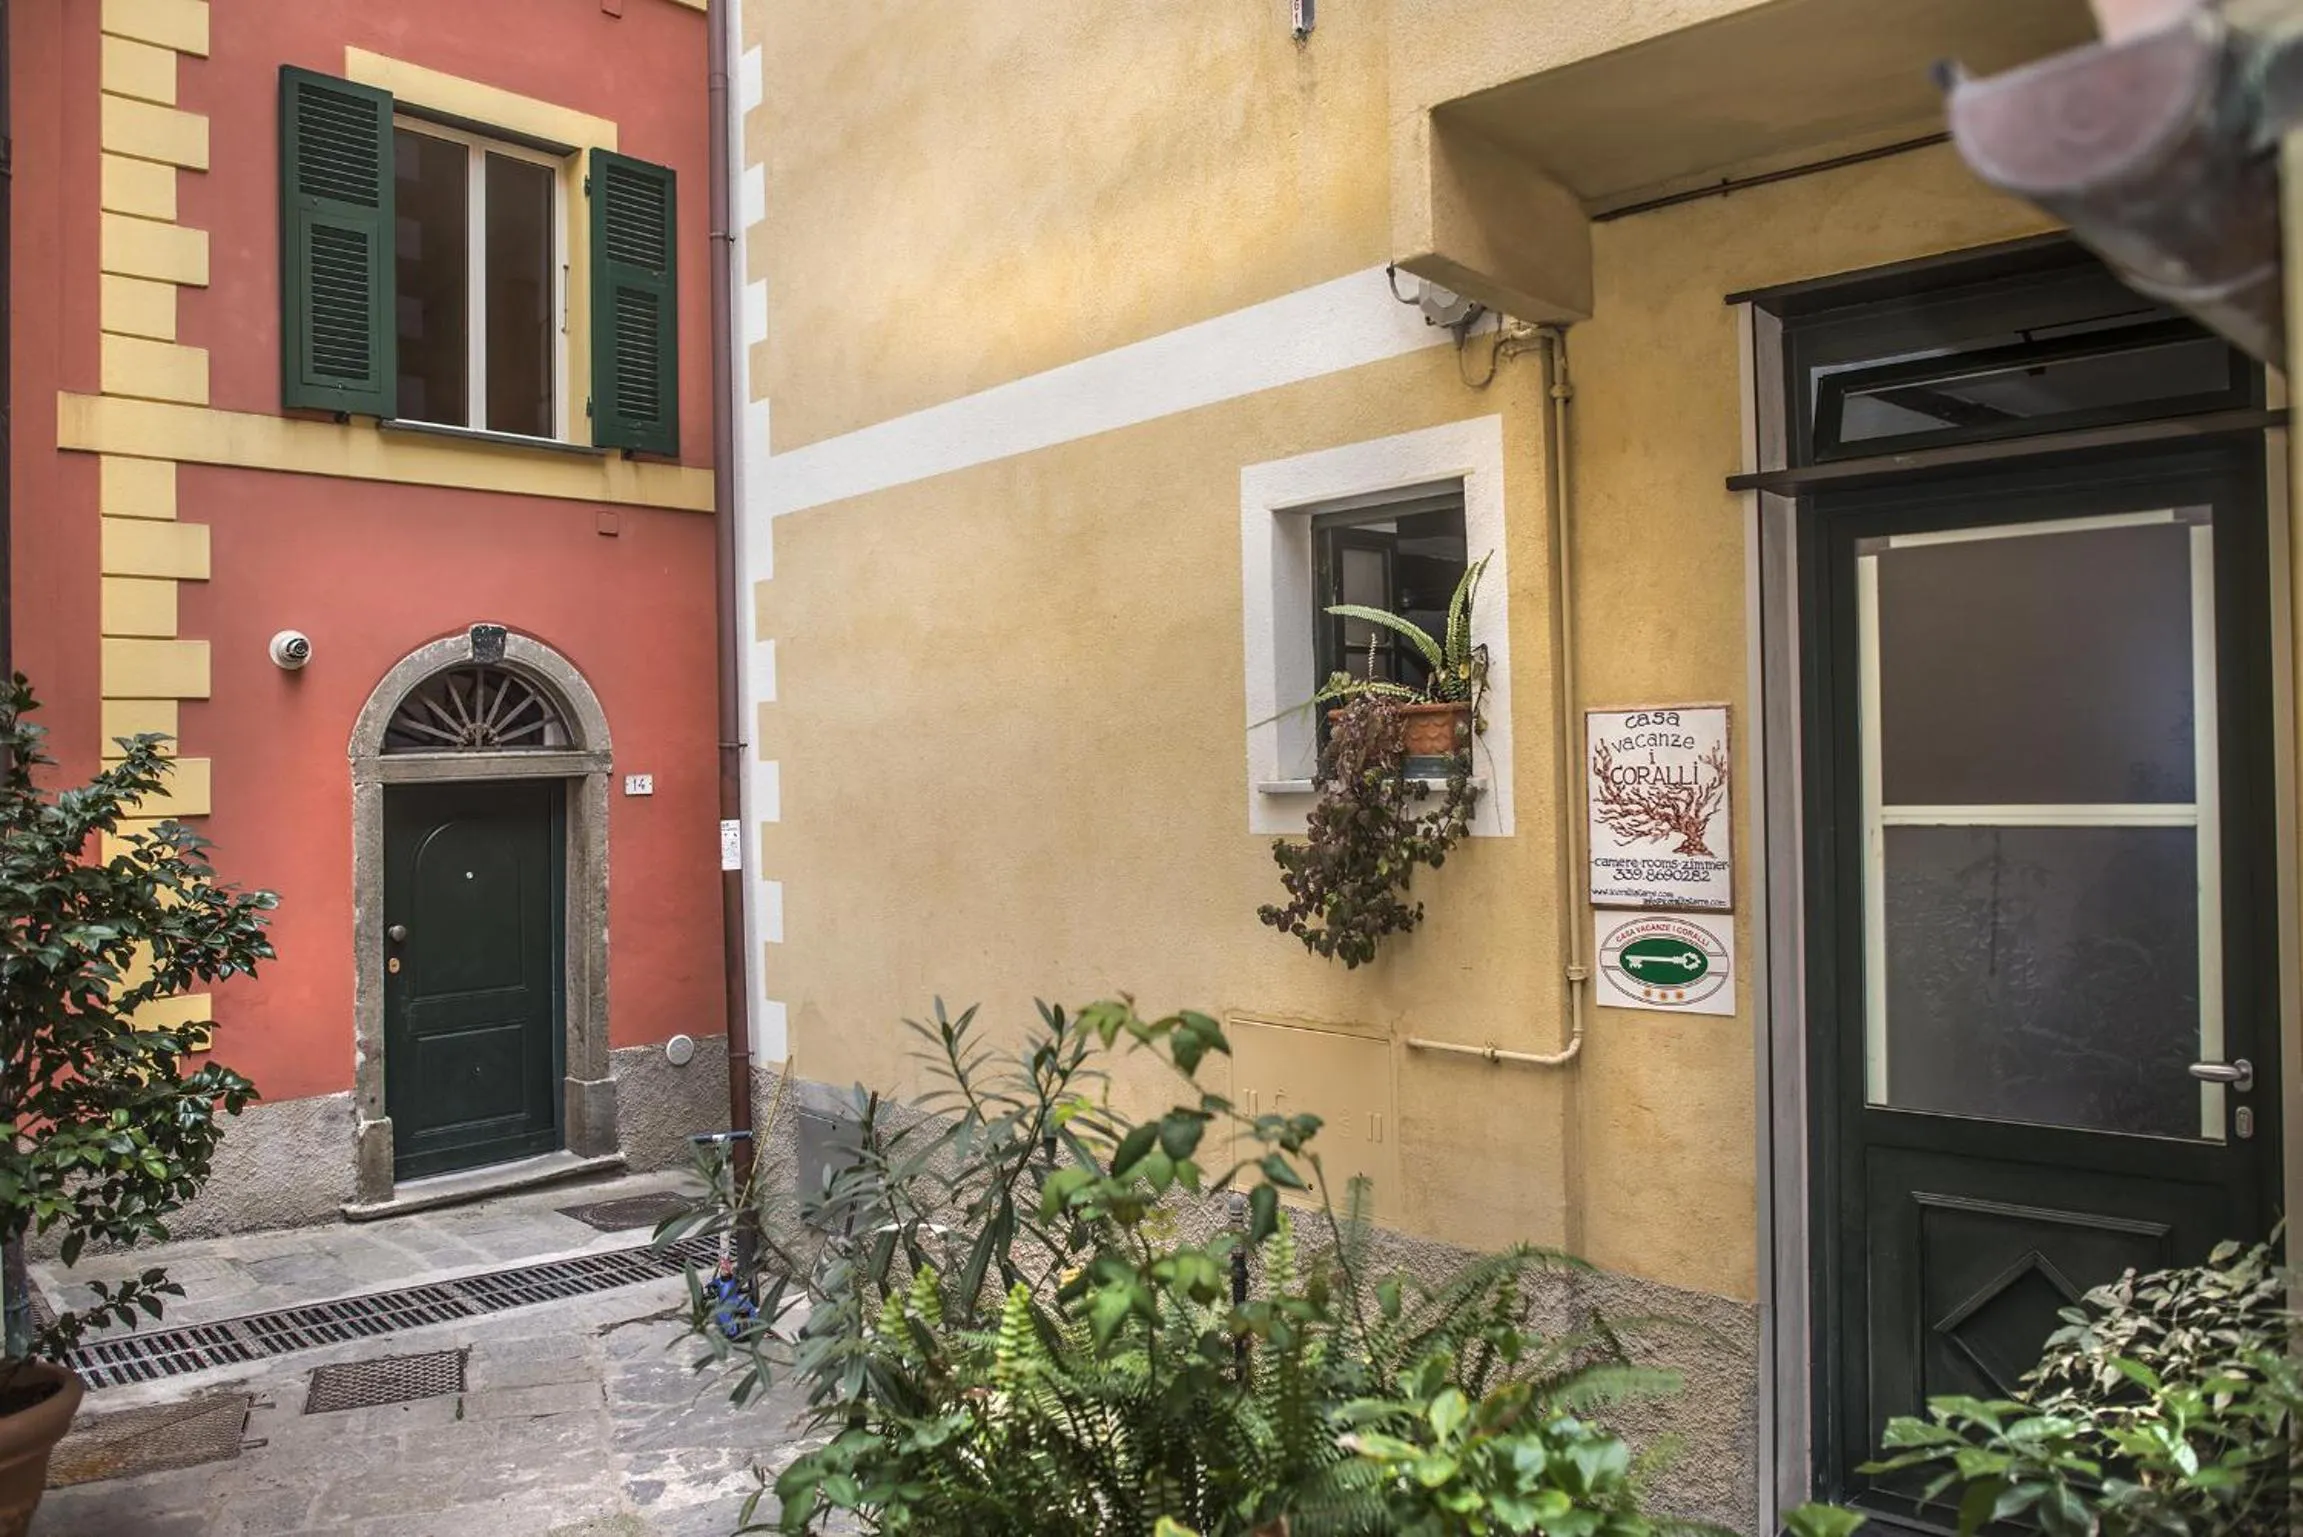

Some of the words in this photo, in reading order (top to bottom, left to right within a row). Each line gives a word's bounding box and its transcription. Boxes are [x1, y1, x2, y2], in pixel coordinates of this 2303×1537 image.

[1625, 711, 1681, 729] casa
[1611, 732, 1695, 753] vacanze
[1648, 748, 1656, 765] i
[1612, 868, 1711, 882] 339.8690282
[1616, 928, 1635, 943] CASA
[1636, 923, 1672, 934] VACANZE
[1676, 926, 1710, 947] CORALLI
